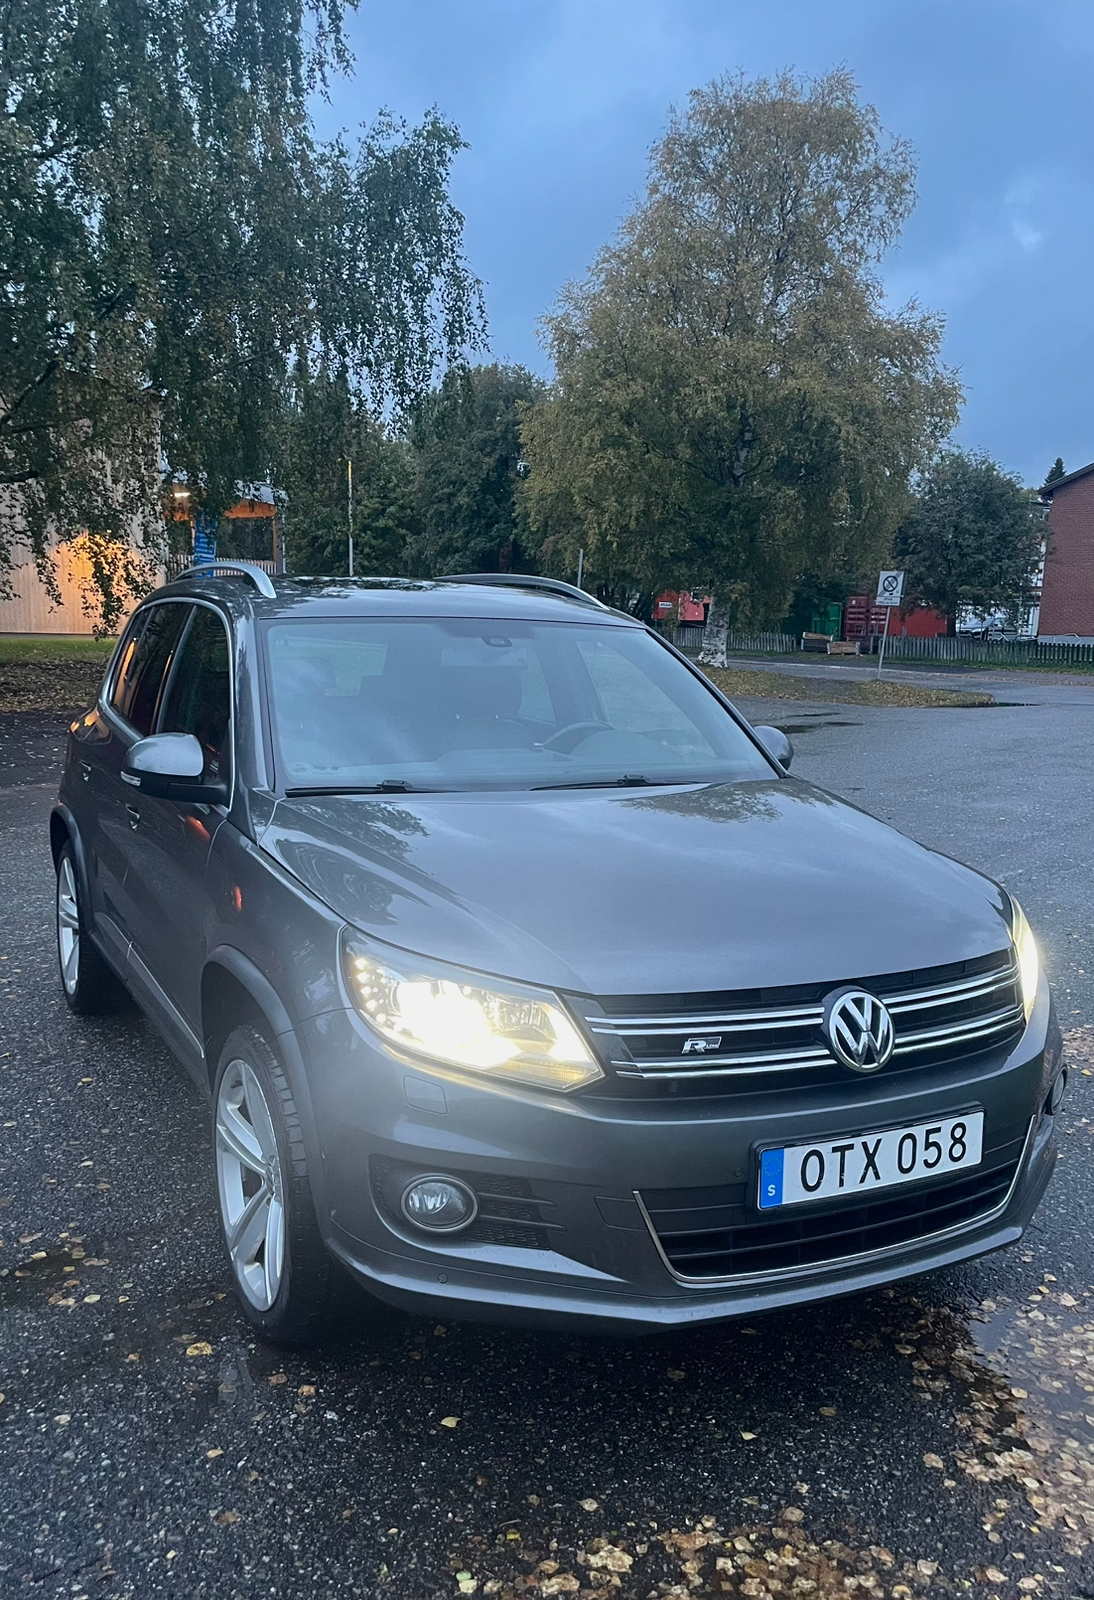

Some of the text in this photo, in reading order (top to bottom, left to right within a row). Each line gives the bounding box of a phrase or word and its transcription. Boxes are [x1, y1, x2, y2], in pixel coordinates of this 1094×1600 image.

[831, 993, 893, 1069] VW
[767, 1184, 776, 1197] S
[800, 1122, 967, 1192] OTX 058
